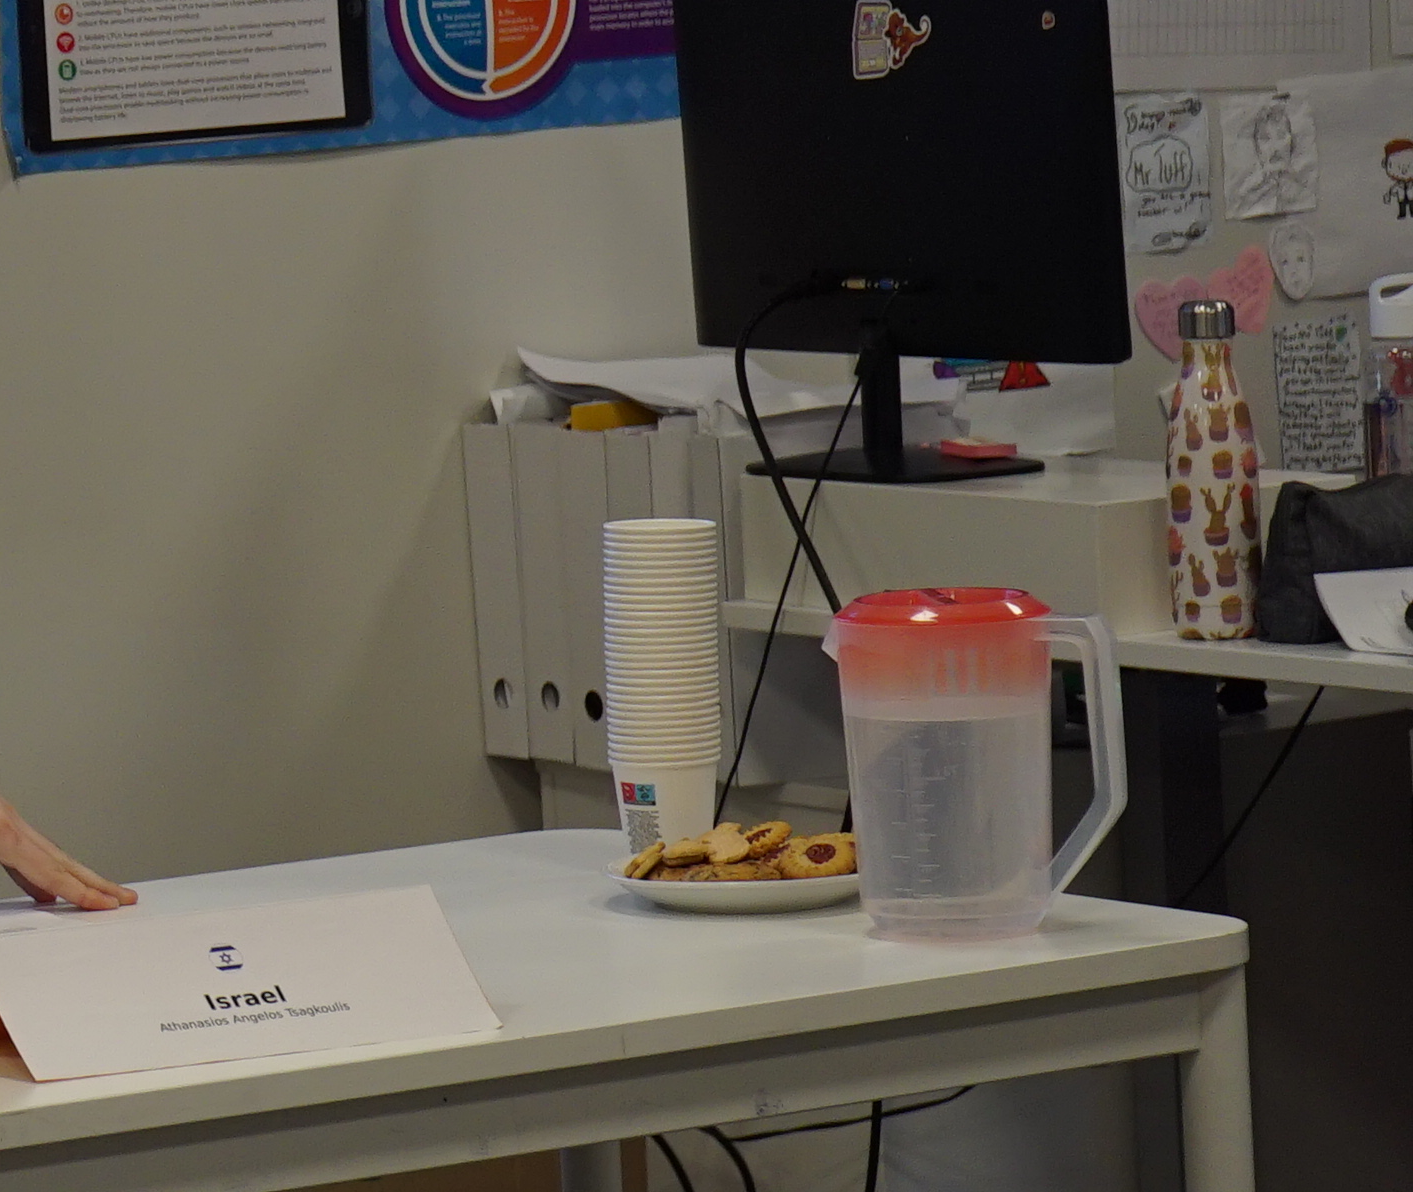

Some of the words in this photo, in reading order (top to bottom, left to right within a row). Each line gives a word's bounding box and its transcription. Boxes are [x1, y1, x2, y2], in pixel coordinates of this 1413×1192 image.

[203, 984, 288, 1012] Israel
[159, 1014, 230, 1034] Athanasios
[232, 1009, 284, 1025] Angelos
[286, 1001, 352, 1017] Tsagkoulis
